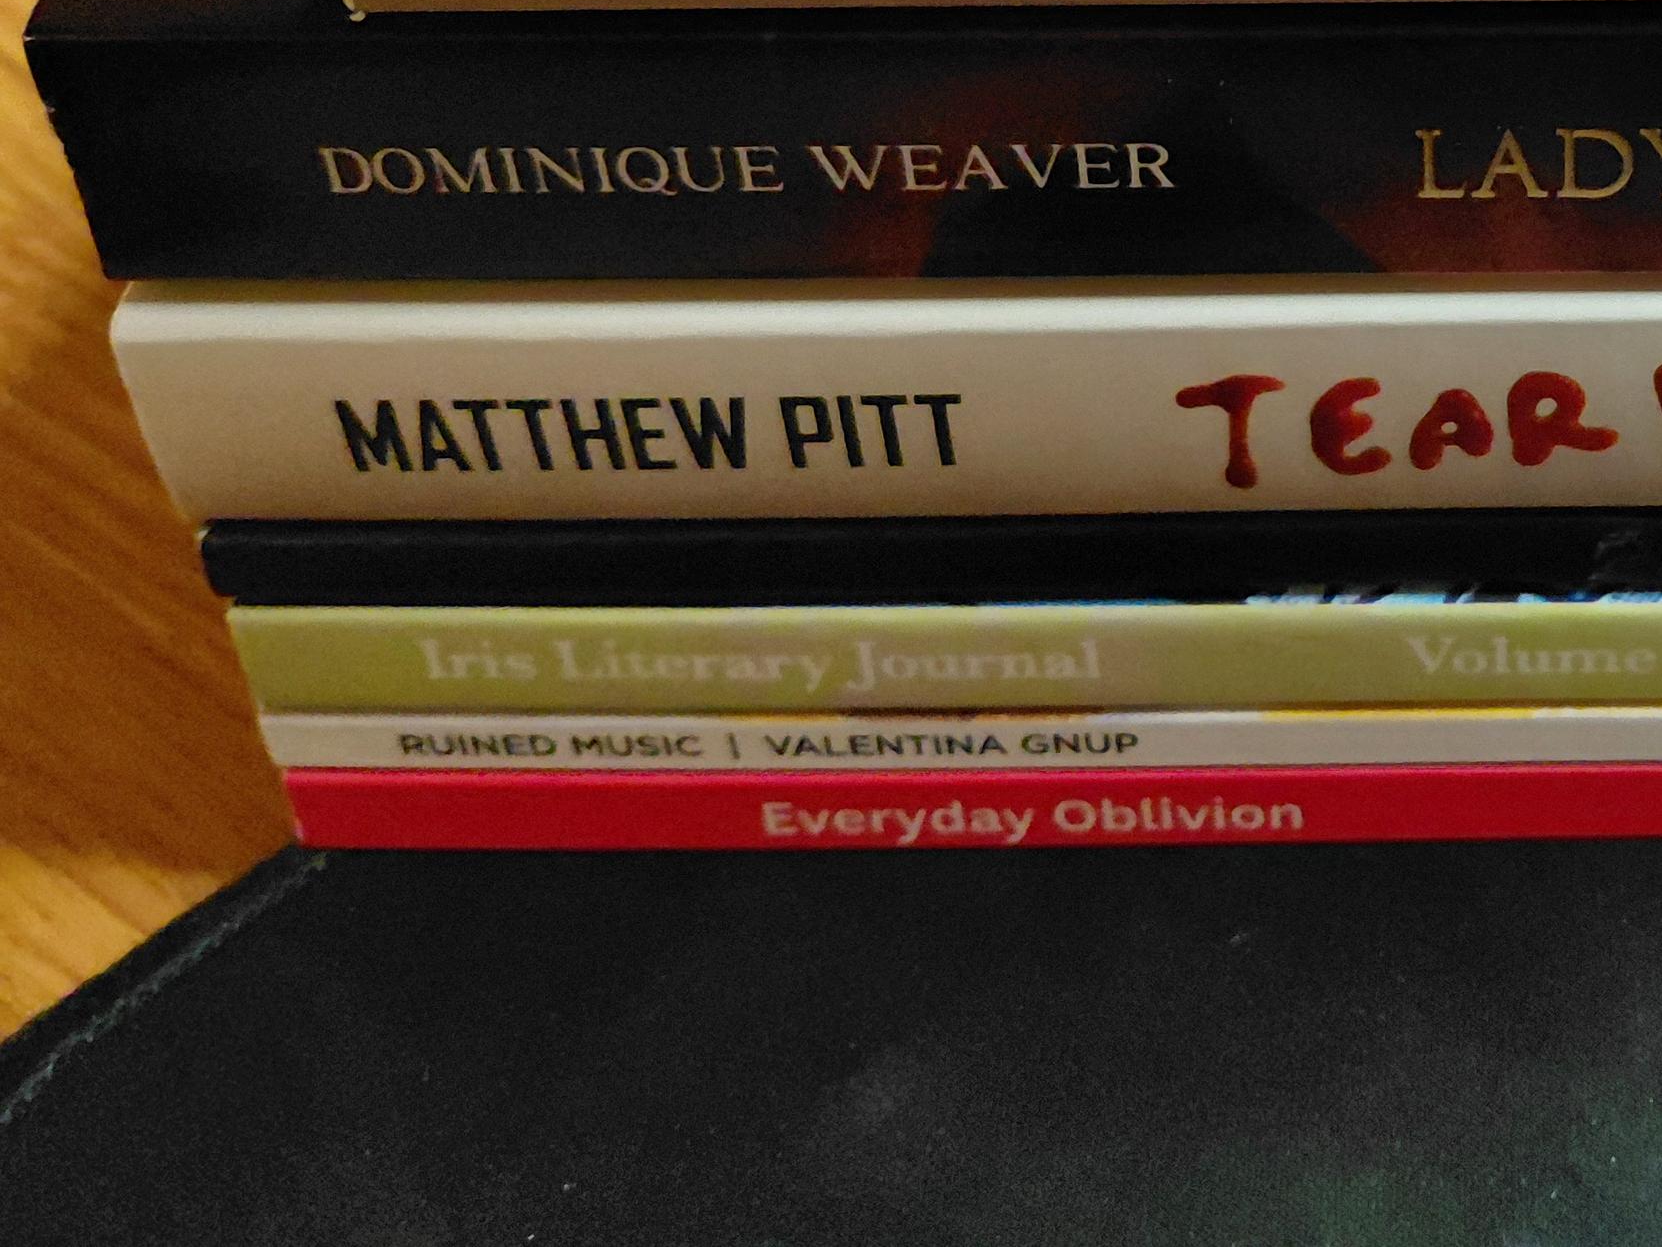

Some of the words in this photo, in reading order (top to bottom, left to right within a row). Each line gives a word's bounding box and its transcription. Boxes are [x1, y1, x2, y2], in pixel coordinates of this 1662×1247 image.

[316, 144, 786, 198] DOMINIQUE
[808, 141, 1178, 191] WEAVER
[333, 395, 748, 473] MATTHEW
[777, 392, 963, 469] PITT
[1174, 369, 1620, 490] TEAR
[420, 637, 535, 682] Iris
[553, 637, 832, 691] Literary
[847, 639, 1102, 691] Journal
[1404, 635, 1659, 675] Volume
[399, 733, 558, 757] RUINED
[572, 733, 704, 757] MUSIC
[763, 733, 1007, 756] VALENTINA
[1020, 732, 1140, 756] GNUP
[760, 799, 1035, 845] Everyday
[1052, 796, 1304, 837] Oblivion
